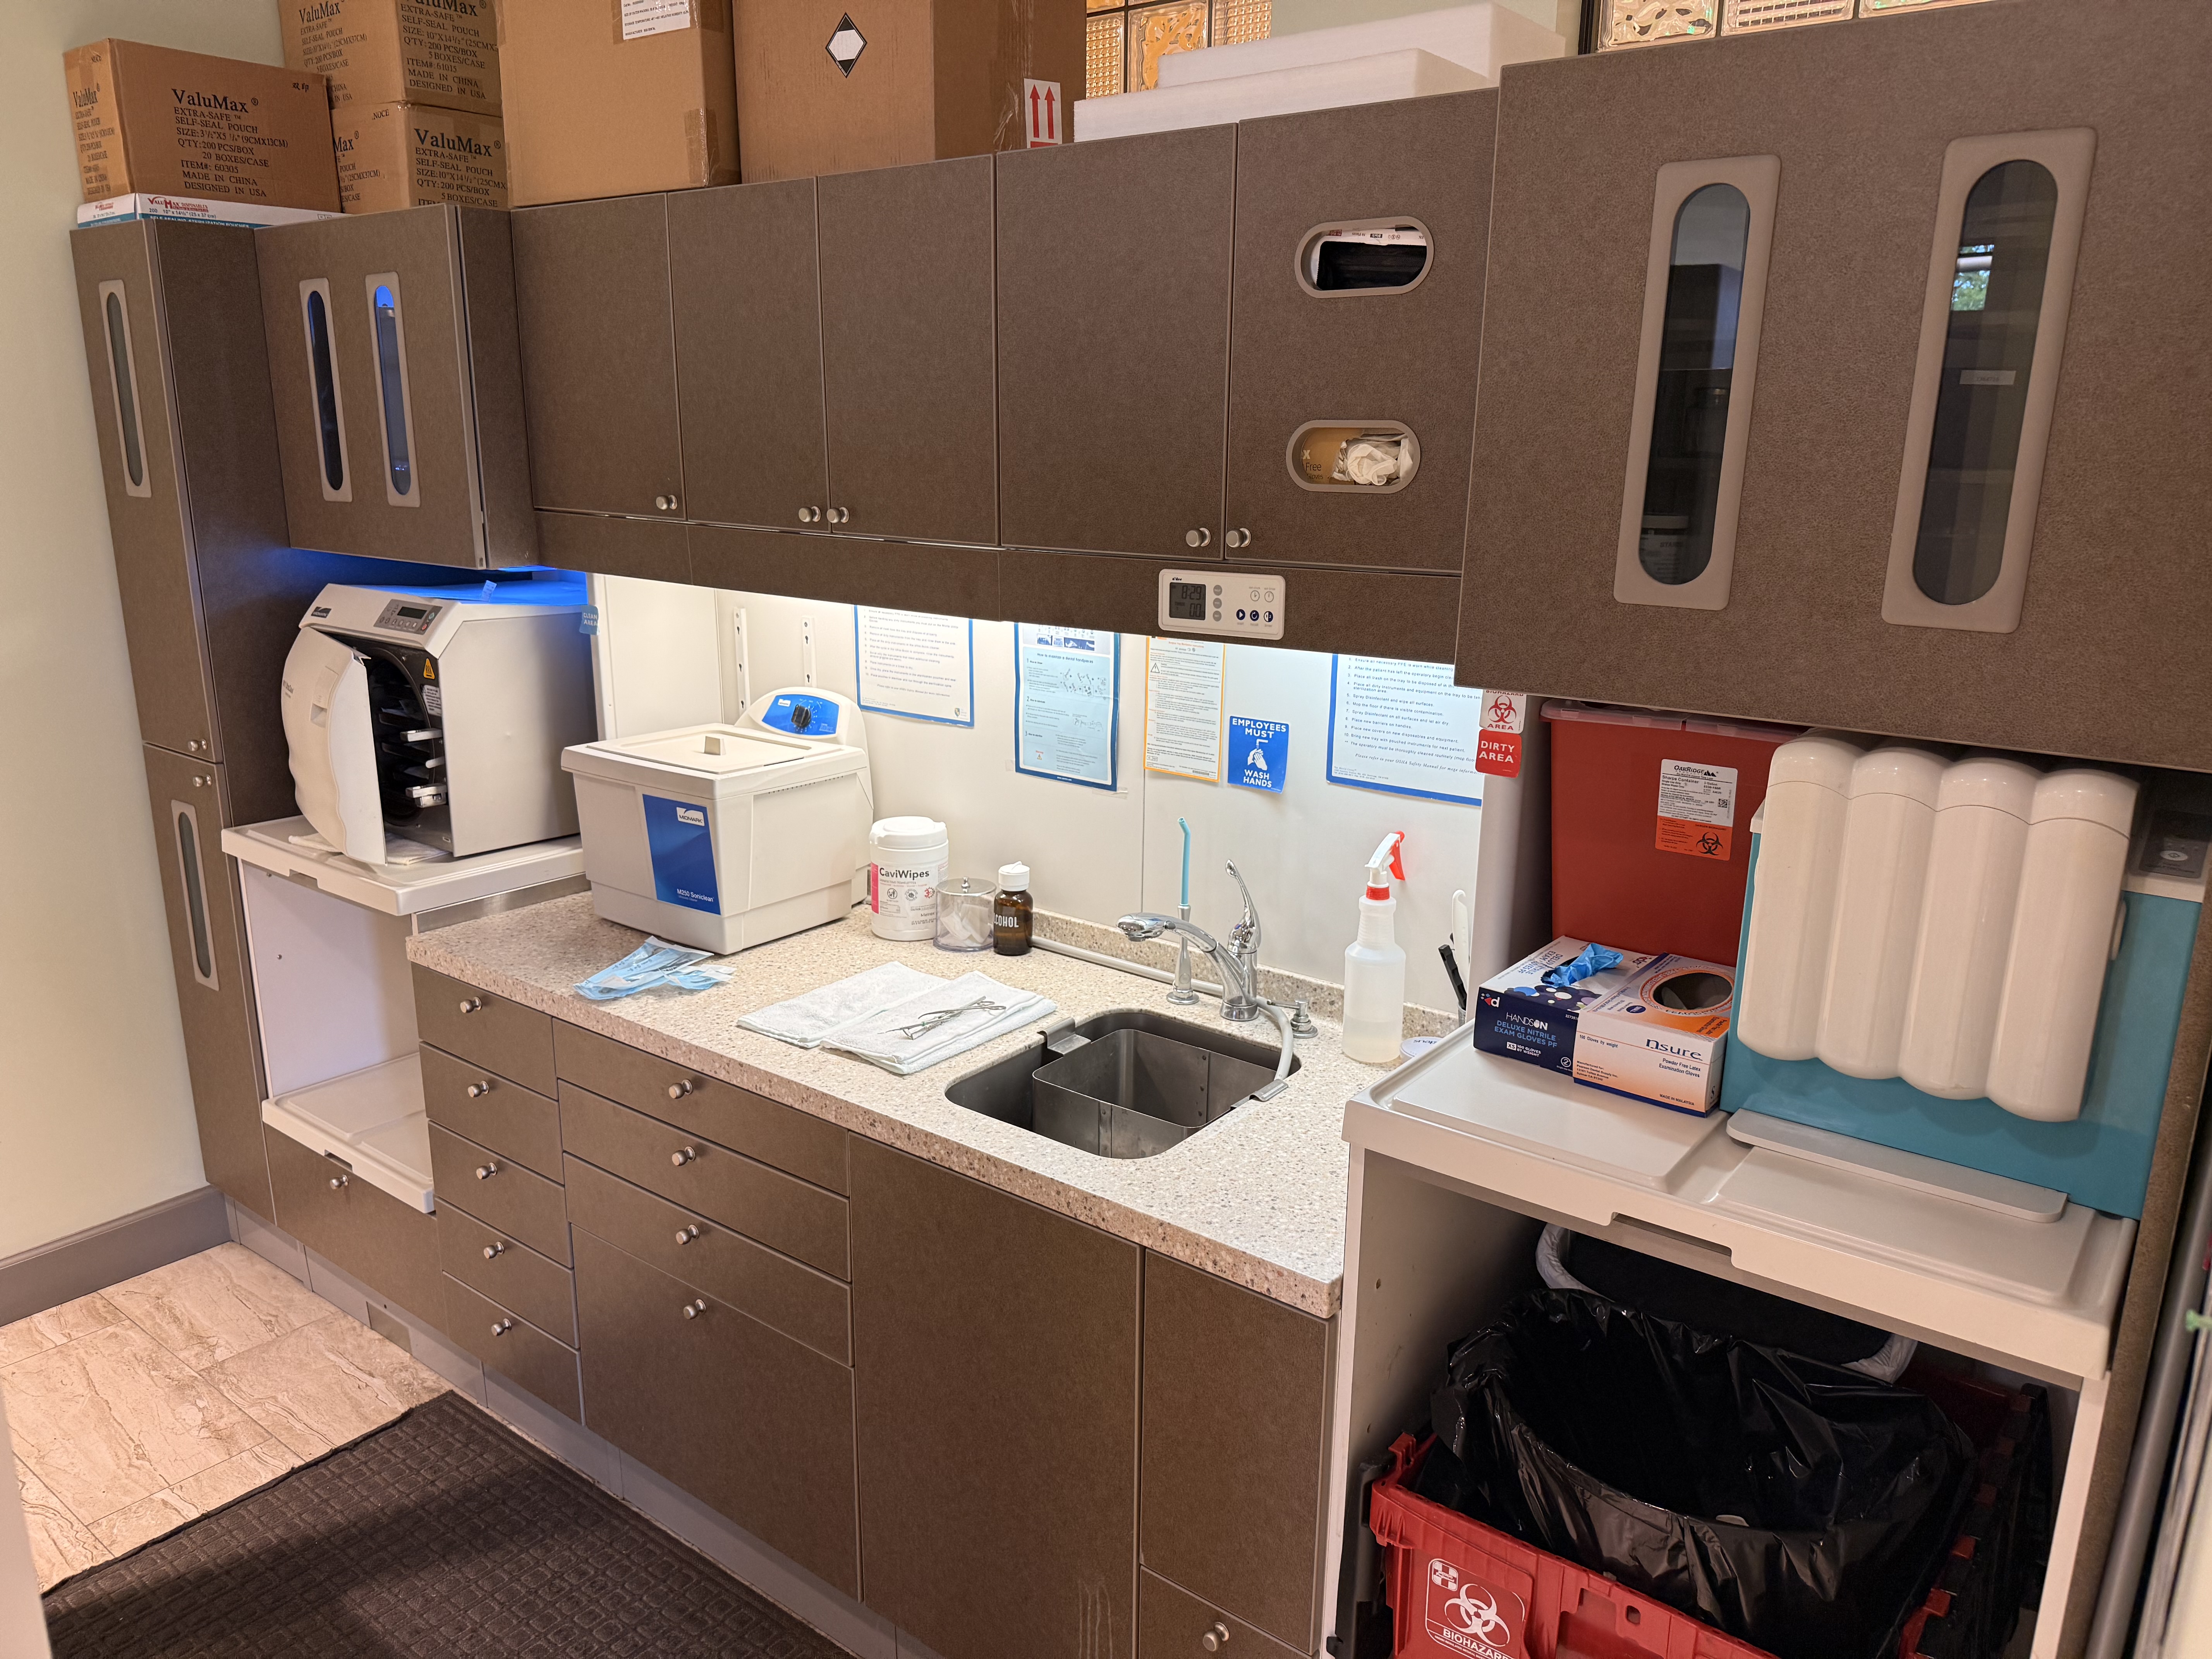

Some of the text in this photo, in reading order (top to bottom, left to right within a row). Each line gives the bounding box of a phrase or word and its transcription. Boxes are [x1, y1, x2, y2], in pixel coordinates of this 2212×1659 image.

[299, 1, 340, 24] ValuMax
[401, 3, 454, 22] EXTRA-SAFE
[326, 27, 342, 38] POUCH
[402, 15, 479, 37] SELF-SEAL POUCH
[444, 45, 477, 58] PCS/BOX
[435, 52, 485, 69] BOXES/CASE
[408, 68, 434, 79] MADE
[453, 77, 479, 88] CHINA
[410, 79, 452, 92] DESIGNED
[471, 90, 486, 99] USA
[171, 89, 248, 113] ValuMax
[174, 107, 230, 121] EXTRA-SAFE
[175, 117, 258, 133] SELF-SEAL POUCH
[218, 143, 254, 155] PCS/BOX
[414, 128, 492, 157] ValuMax
[215, 153, 269, 167] BOXES/CASE
[416, 147, 469, 162] EXTRA-SAFE
[215, 164, 239, 173] 60305
[416, 158, 492, 176] SELF-SEAL POUCH
[182, 170, 210, 180] MADE
[229, 176, 257, 186] CHINA
[184, 181, 230, 192] DESIGNED
[250, 189, 266, 197] USA
[456, 184, 489, 196] PCS/BOX
[447, 194, 497, 207] BOXES/CASE
[1306, 462, 1321, 471] Free
[1182, 585, 1202, 600] 8:29
[1232, 718, 1286, 732] EMPLOYEES
[1245, 728, 1274, 738] MUST
[1481, 740, 1515, 752] DIRTY
[1479, 751, 1514, 763] AREA
[1244, 769, 1269, 780] WASH
[1243, 776, 1272, 788] HANDS
[679, 814, 703, 823] MIDMARK
[879, 867, 929, 880] CaviWipes
[677, 889, 690, 897] M250
[690, 892, 714, 902] Soniclean
[994, 914, 1019, 927] COHOL
[1494, 1026, 1515, 1036] EXAM
[1517, 1032, 1546, 1045] GLOVES
[1497, 1020, 1556, 1041] DELUXE NITRILE
[1646, 1039, 1703, 1061] nsure
[1659, 1063, 1685, 1073] Examination
[1711, 1085, 1715, 1099] S
[1676, 1097, 1694, 1106] MALAYSIA
[1443, 1628, 1509, 1659] BIOHAZAR
